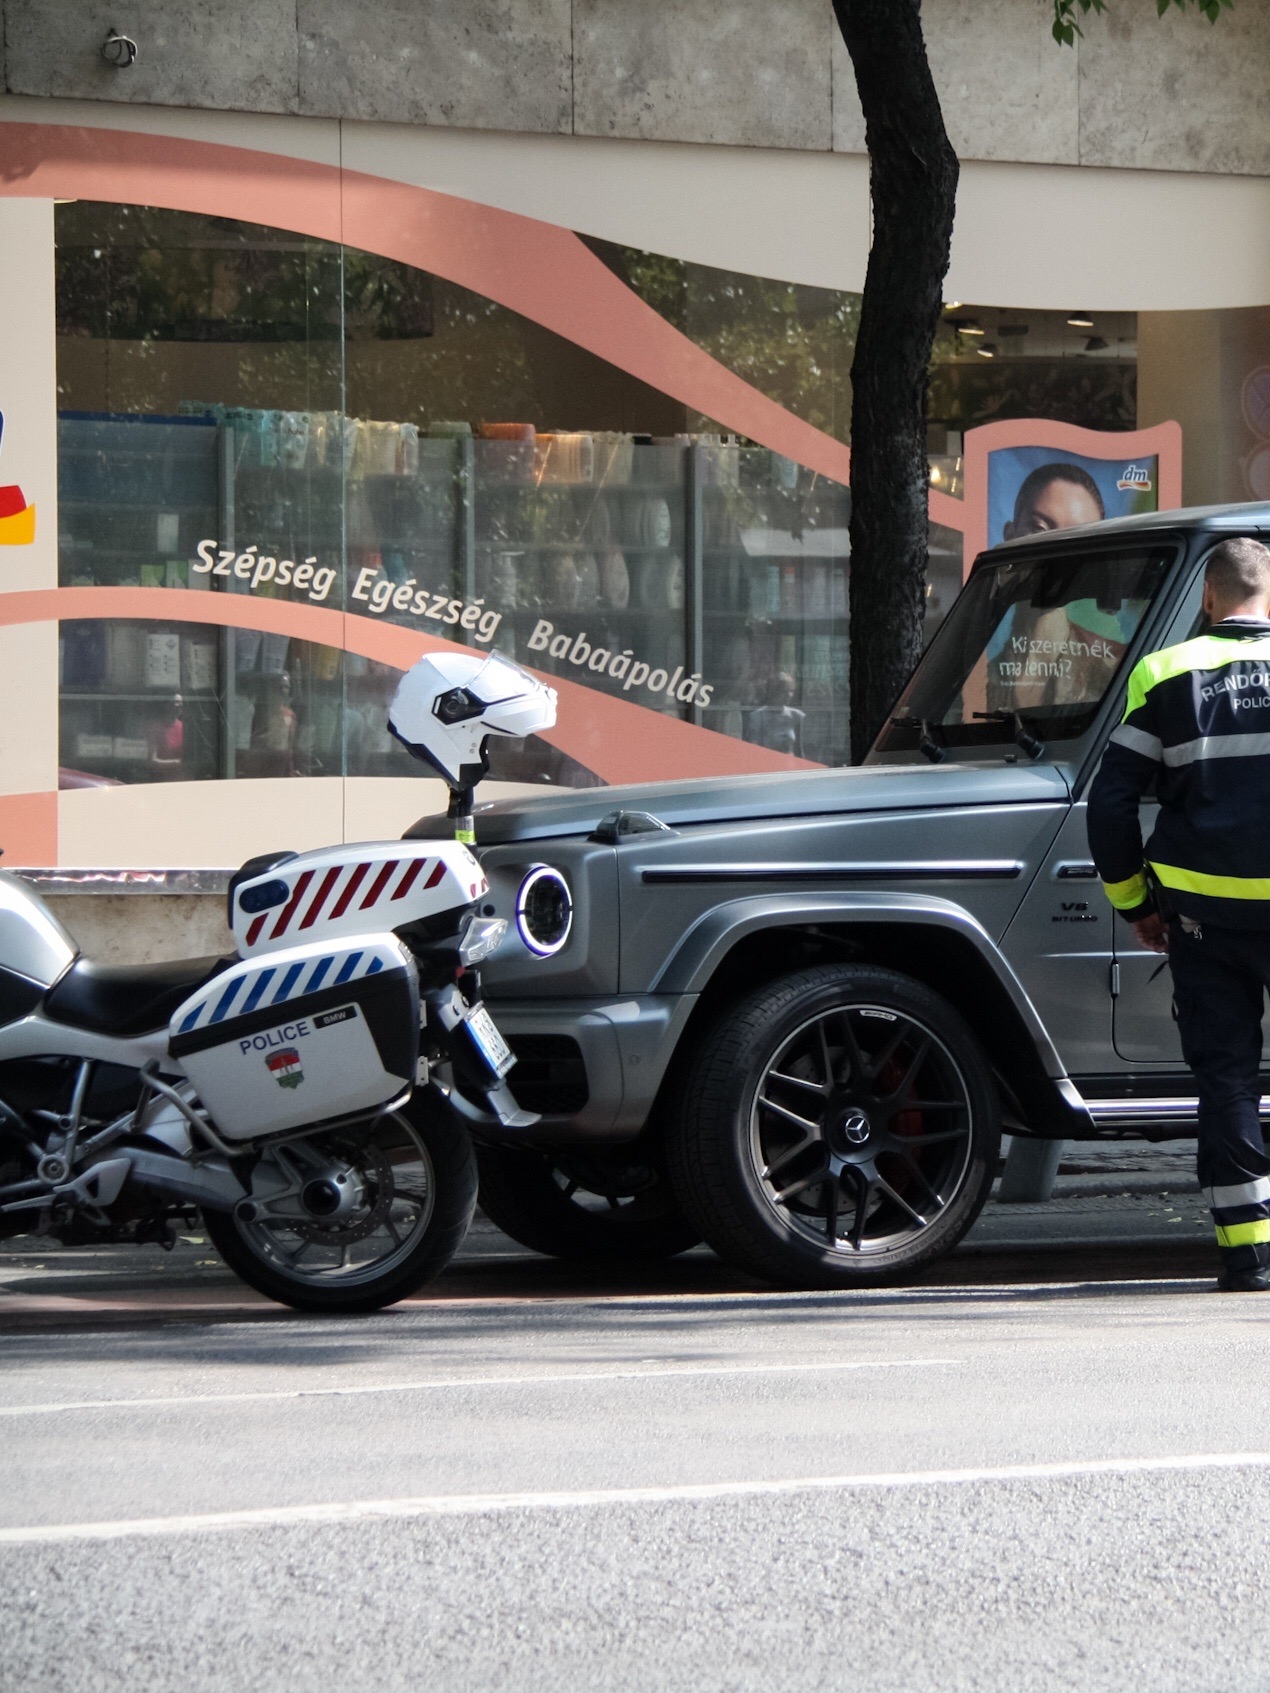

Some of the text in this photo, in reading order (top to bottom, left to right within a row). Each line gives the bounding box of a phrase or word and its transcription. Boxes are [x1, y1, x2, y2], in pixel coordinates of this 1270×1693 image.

[1123, 465, 1147, 481] dm
[193, 540, 714, 708] Szépség Egészség Babaápolás
[1011, 636, 1027, 653] Ki
[1000, 662, 1021, 677] ma
[322, 1011, 346, 1024] BMW
[240, 1021, 310, 1055] POLICE
